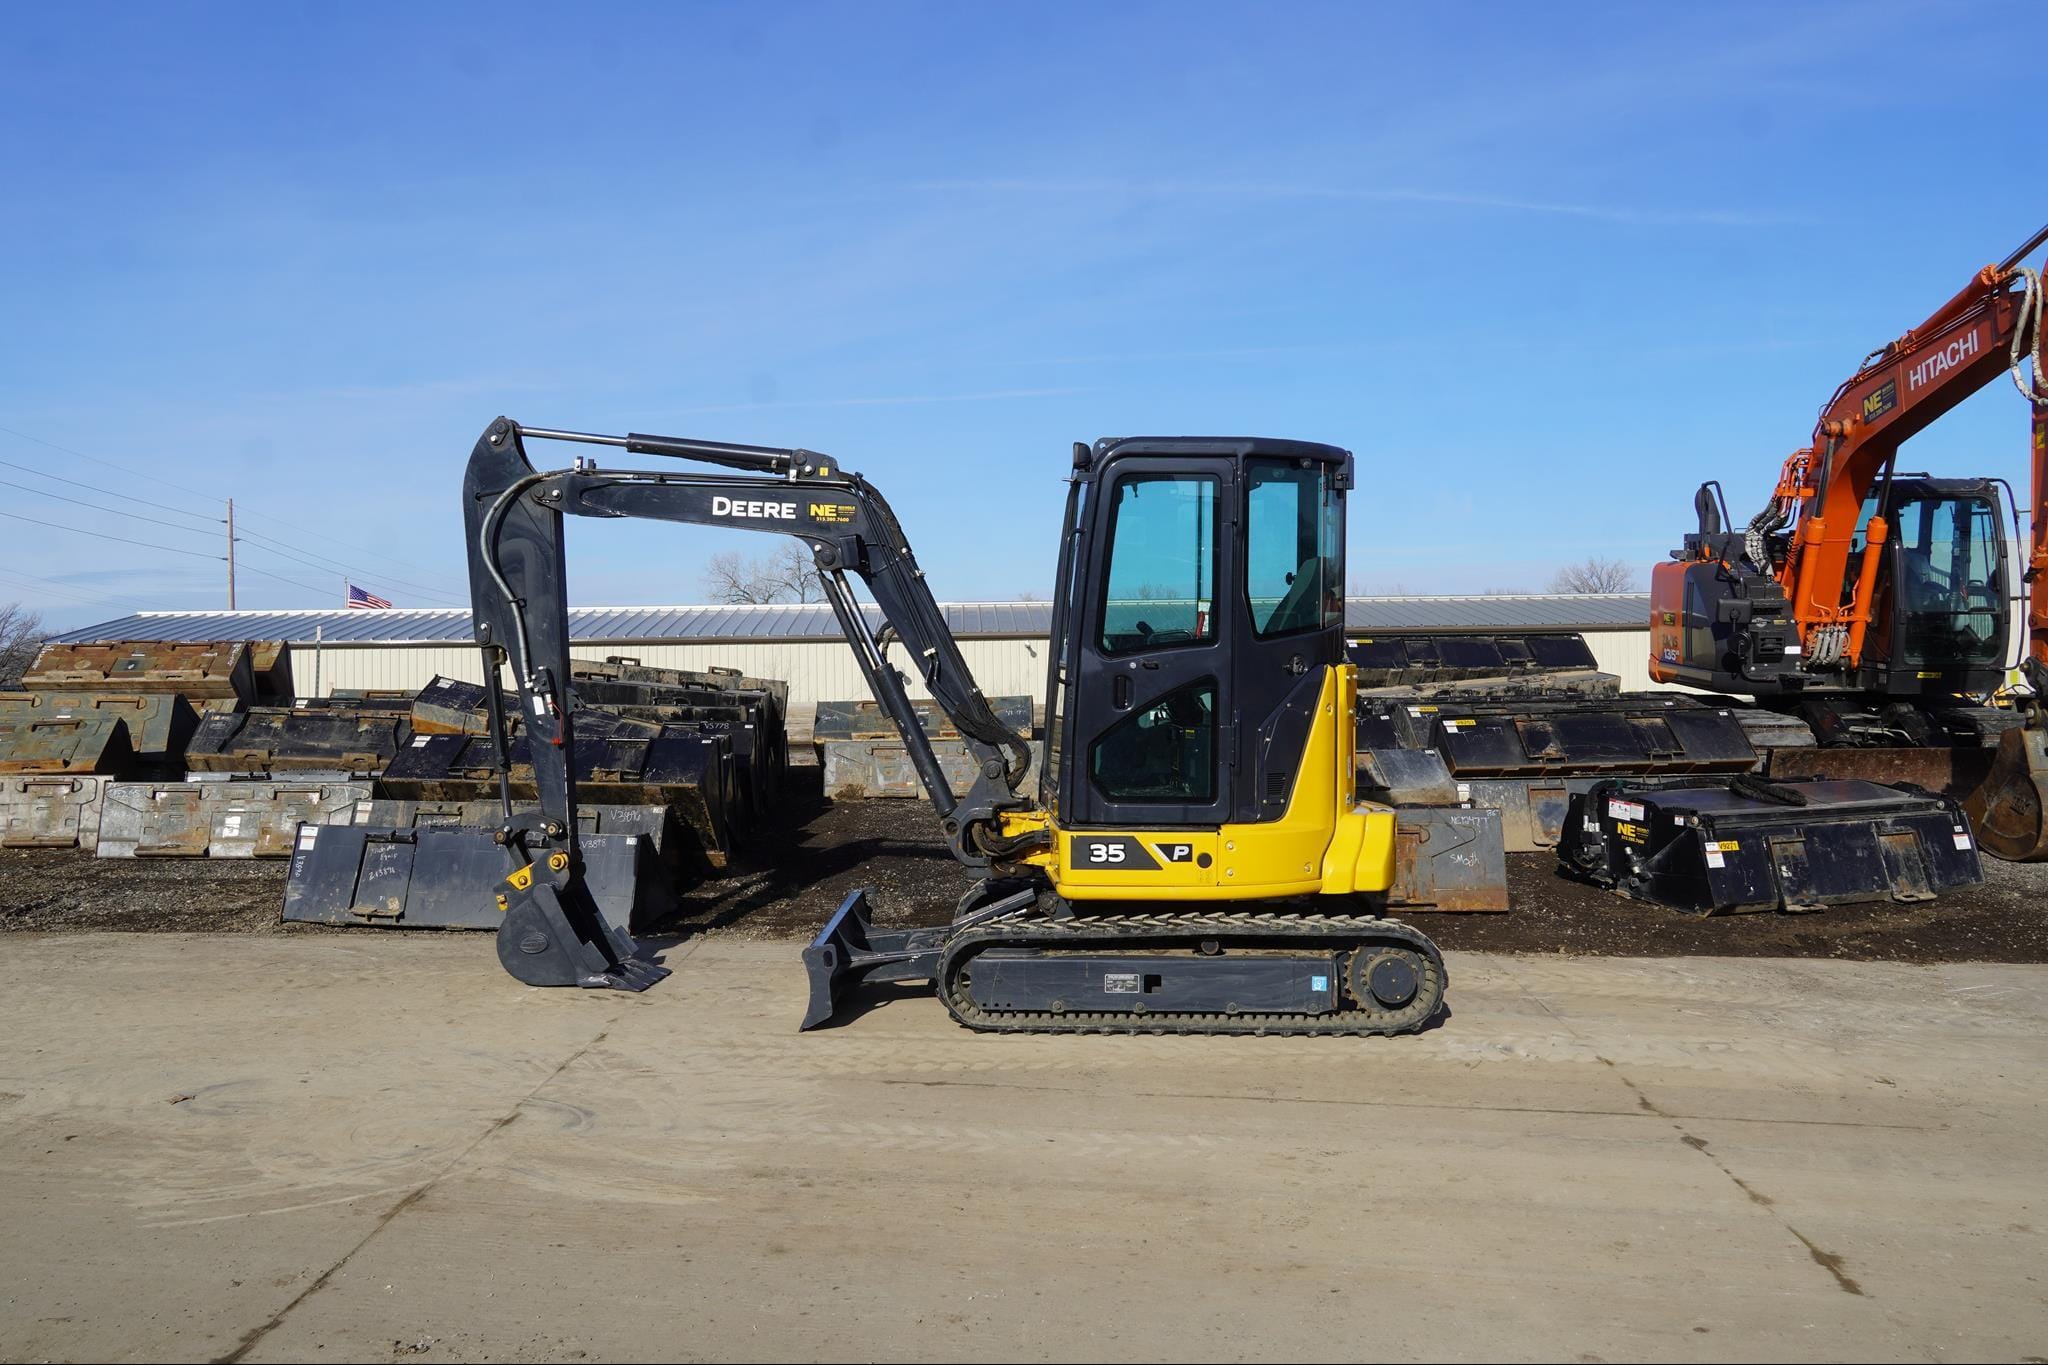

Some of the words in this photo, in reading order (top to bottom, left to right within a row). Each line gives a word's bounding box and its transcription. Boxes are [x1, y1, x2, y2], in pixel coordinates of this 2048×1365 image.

[1909, 329, 1979, 391] HITACHI
[1863, 389, 1882, 416] NE
[712, 496, 797, 519] DEERE
[810, 504, 837, 517] NE
[1617, 822, 1636, 837] NE
[1090, 844, 1126, 863] 35
[1172, 846, 1190, 861] P
